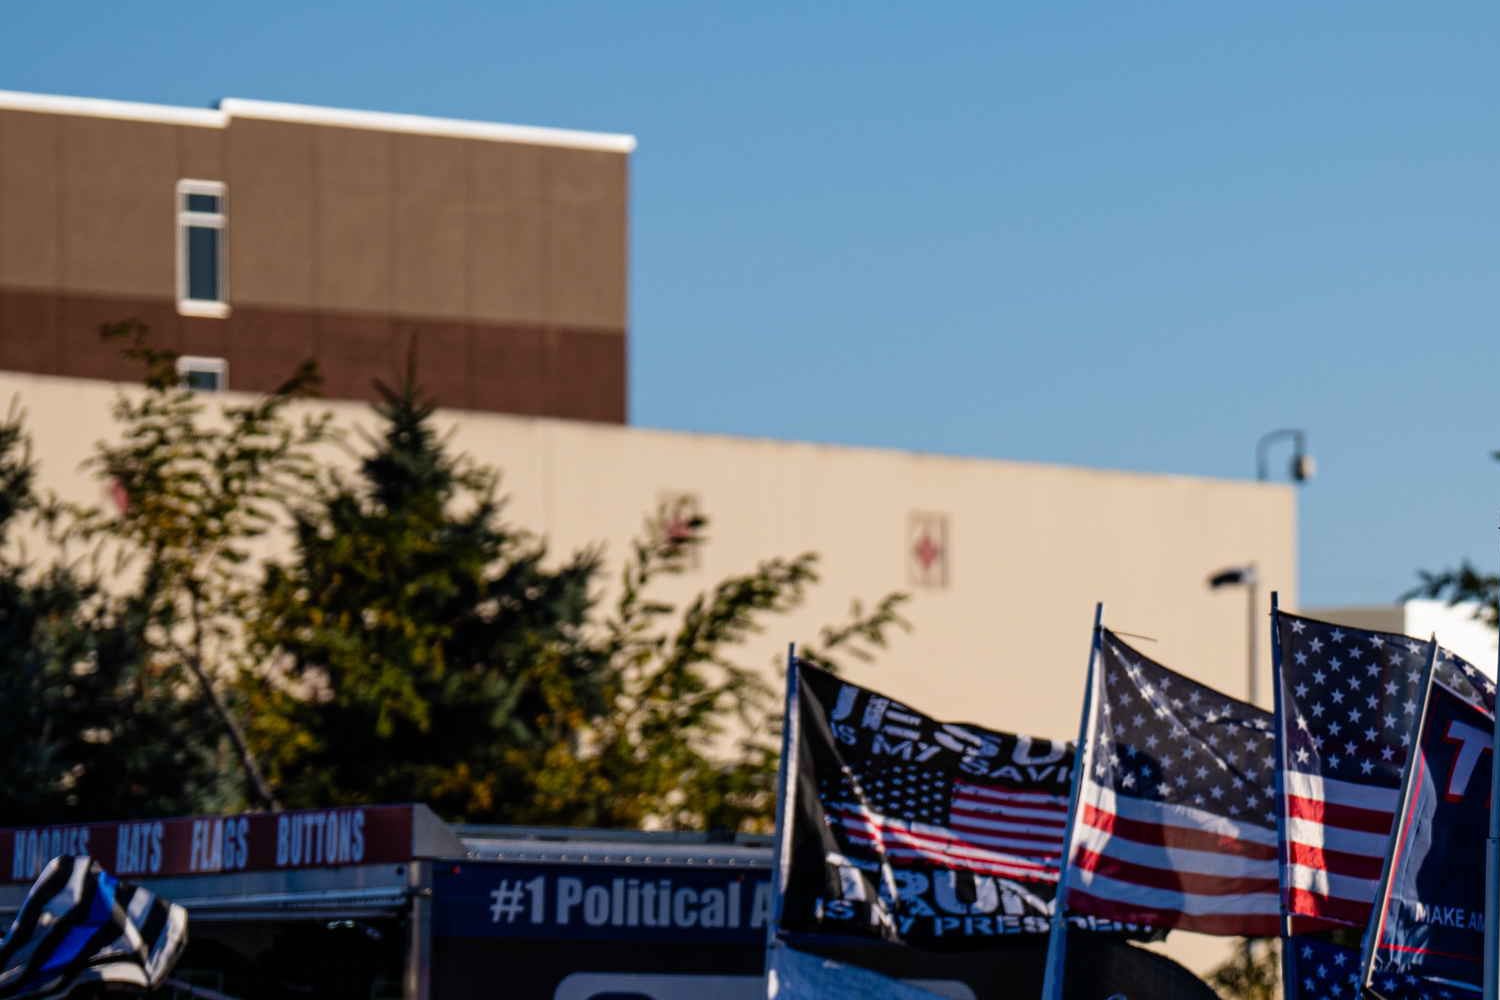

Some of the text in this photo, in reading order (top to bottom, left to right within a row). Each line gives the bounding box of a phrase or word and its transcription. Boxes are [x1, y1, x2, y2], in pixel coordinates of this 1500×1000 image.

[830, 683, 1087, 767] JESU
[871, 732, 942, 763] MY
[957, 755, 1075, 783] SAVI
[116, 821, 164, 875] HATS
[189, 816, 250, 872] FLAGS
[276, 808, 366, 867] BUTTONS
[489, 875, 545, 925] #1
[555, 876, 742, 929] Political
[813, 896, 856, 921] IS
[825, 851, 1058, 918] TRUM
[1414, 901, 1466, 929] MAKE
